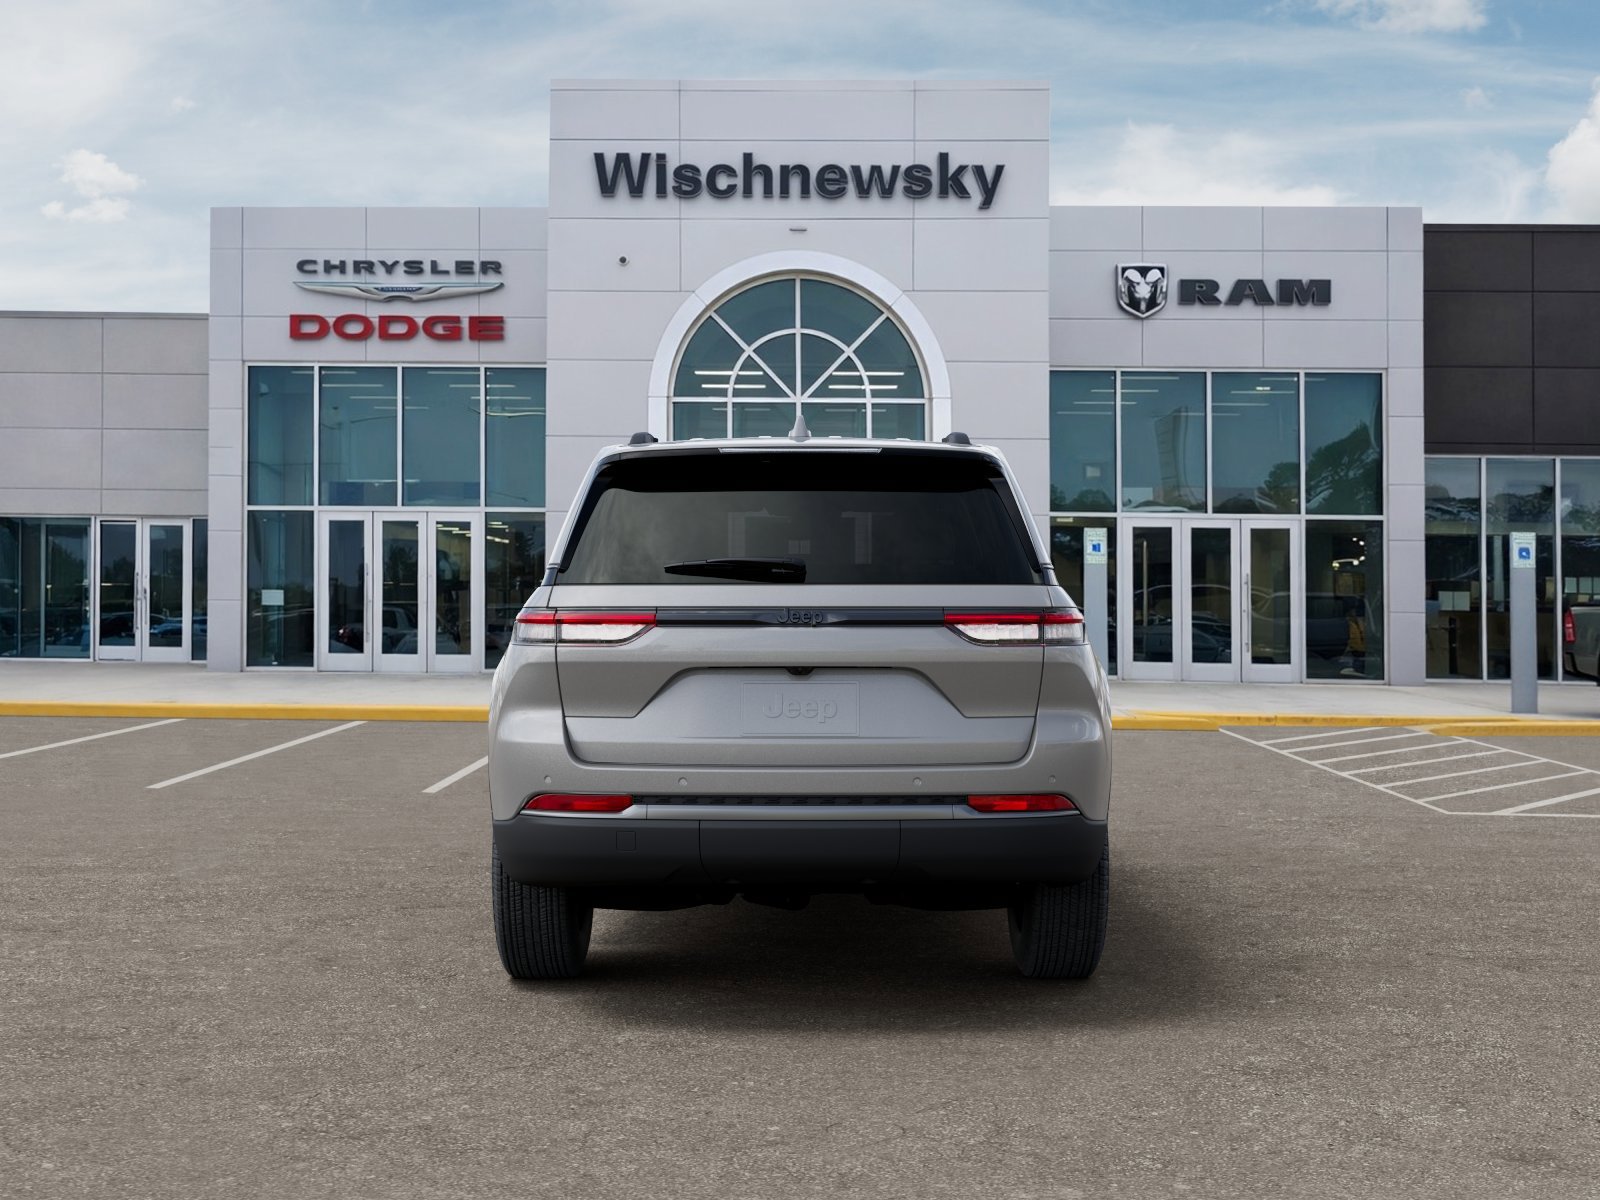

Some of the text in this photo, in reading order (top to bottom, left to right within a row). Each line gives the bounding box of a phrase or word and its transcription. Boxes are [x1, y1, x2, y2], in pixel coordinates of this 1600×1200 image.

[593, 152, 1006, 210] Wischnewsky
[296, 259, 503, 275] CHRYSLER
[1177, 278, 1332, 306] RAM
[289, 313, 505, 341] DODGE
[776, 607, 824, 629] Jeep
[763, 688, 838, 724] Jeep
